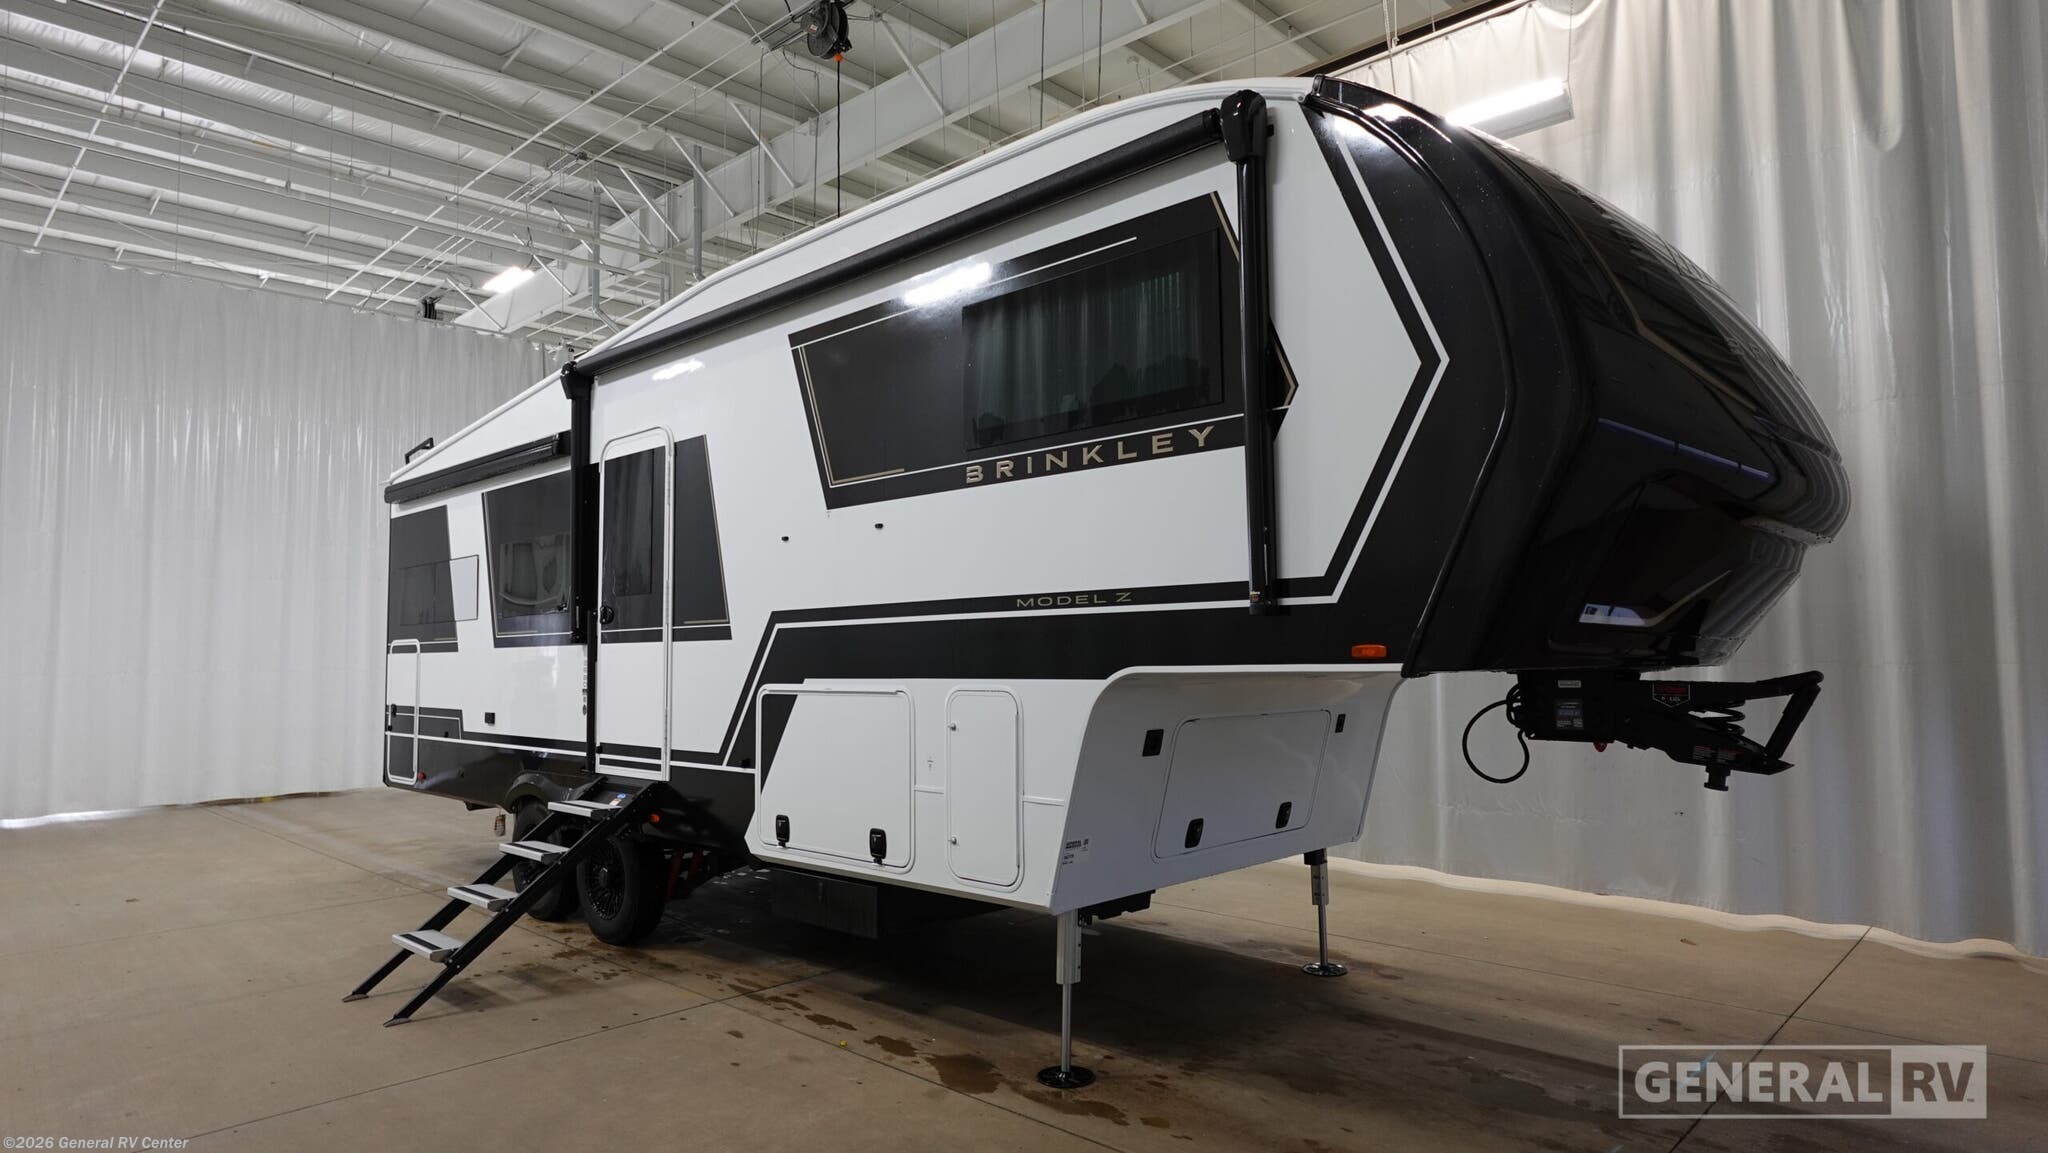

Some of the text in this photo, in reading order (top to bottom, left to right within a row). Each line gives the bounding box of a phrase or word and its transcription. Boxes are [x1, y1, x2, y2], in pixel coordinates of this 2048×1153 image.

[966, 425, 1215, 484] BRINKLEY
[1016, 592, 1132, 608] MODEL Z
